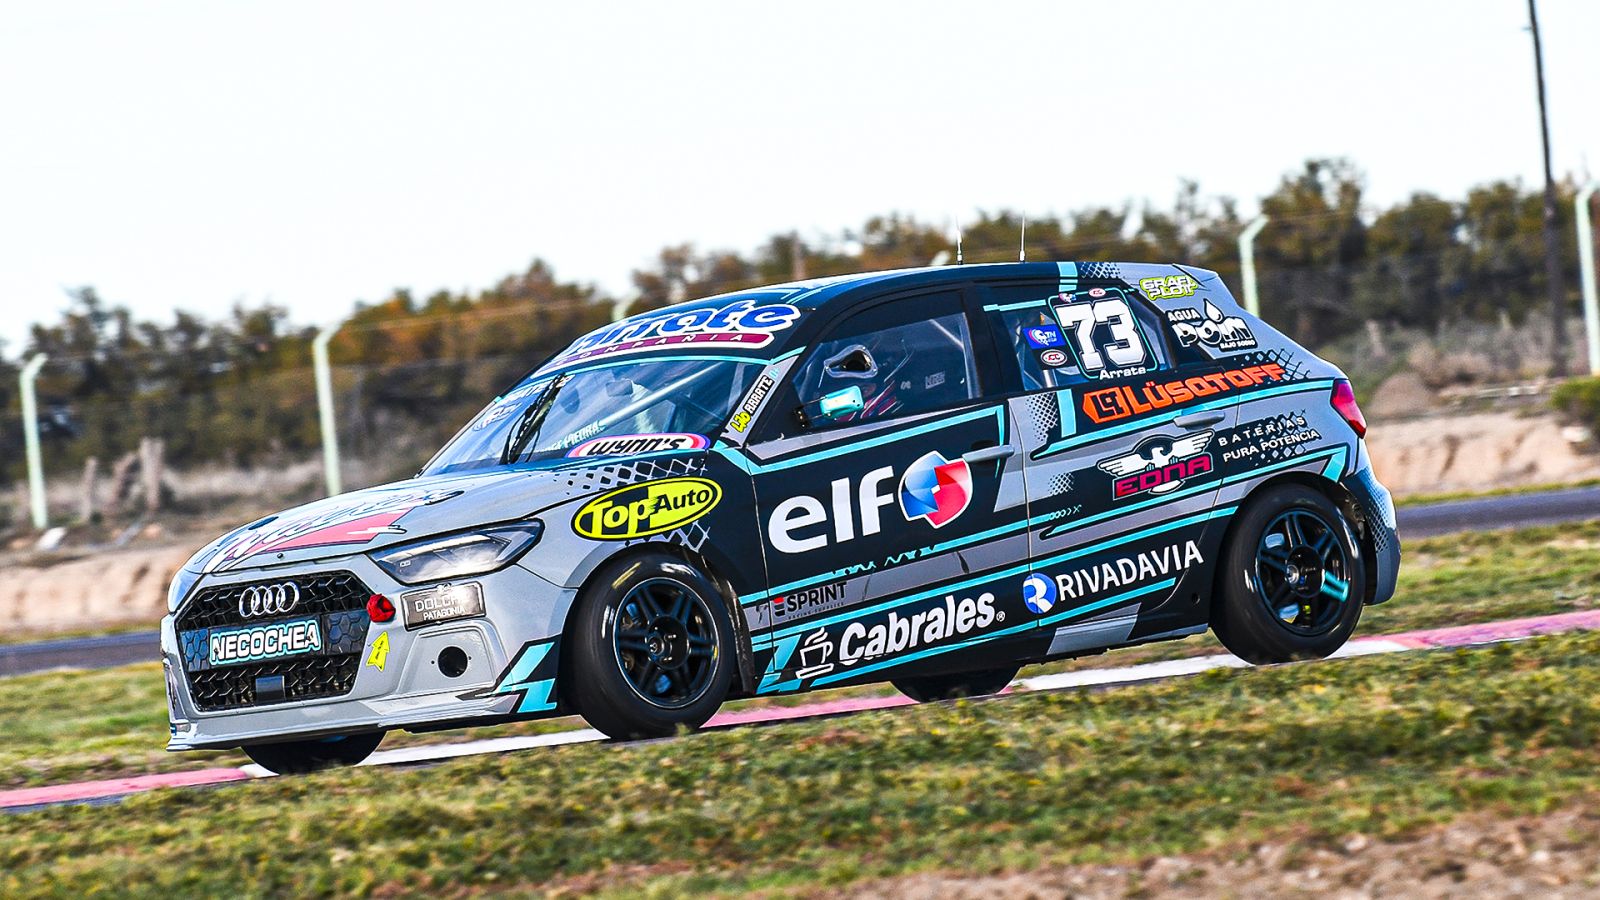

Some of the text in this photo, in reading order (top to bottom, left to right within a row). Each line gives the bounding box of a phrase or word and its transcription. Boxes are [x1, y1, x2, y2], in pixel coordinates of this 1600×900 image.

[1055, 299, 1146, 369] 73
[1167, 308, 1200, 321] AGUA
[1099, 367, 1146, 380] Arrate
[743, 375, 774, 414] ARRATE
[1219, 416, 1306, 447] BATERIAS
[1222, 430, 1320, 463] PURA POTENCIA
[1116, 455, 1212, 497] EDNA
[768, 465, 895, 553] elf
[1056, 540, 1204, 601] RIVADAVIA
[423, 607, 466, 621] PATAGONIA
[839, 593, 996, 665] Cabrales
[212, 623, 321, 662] NECOCHEA
